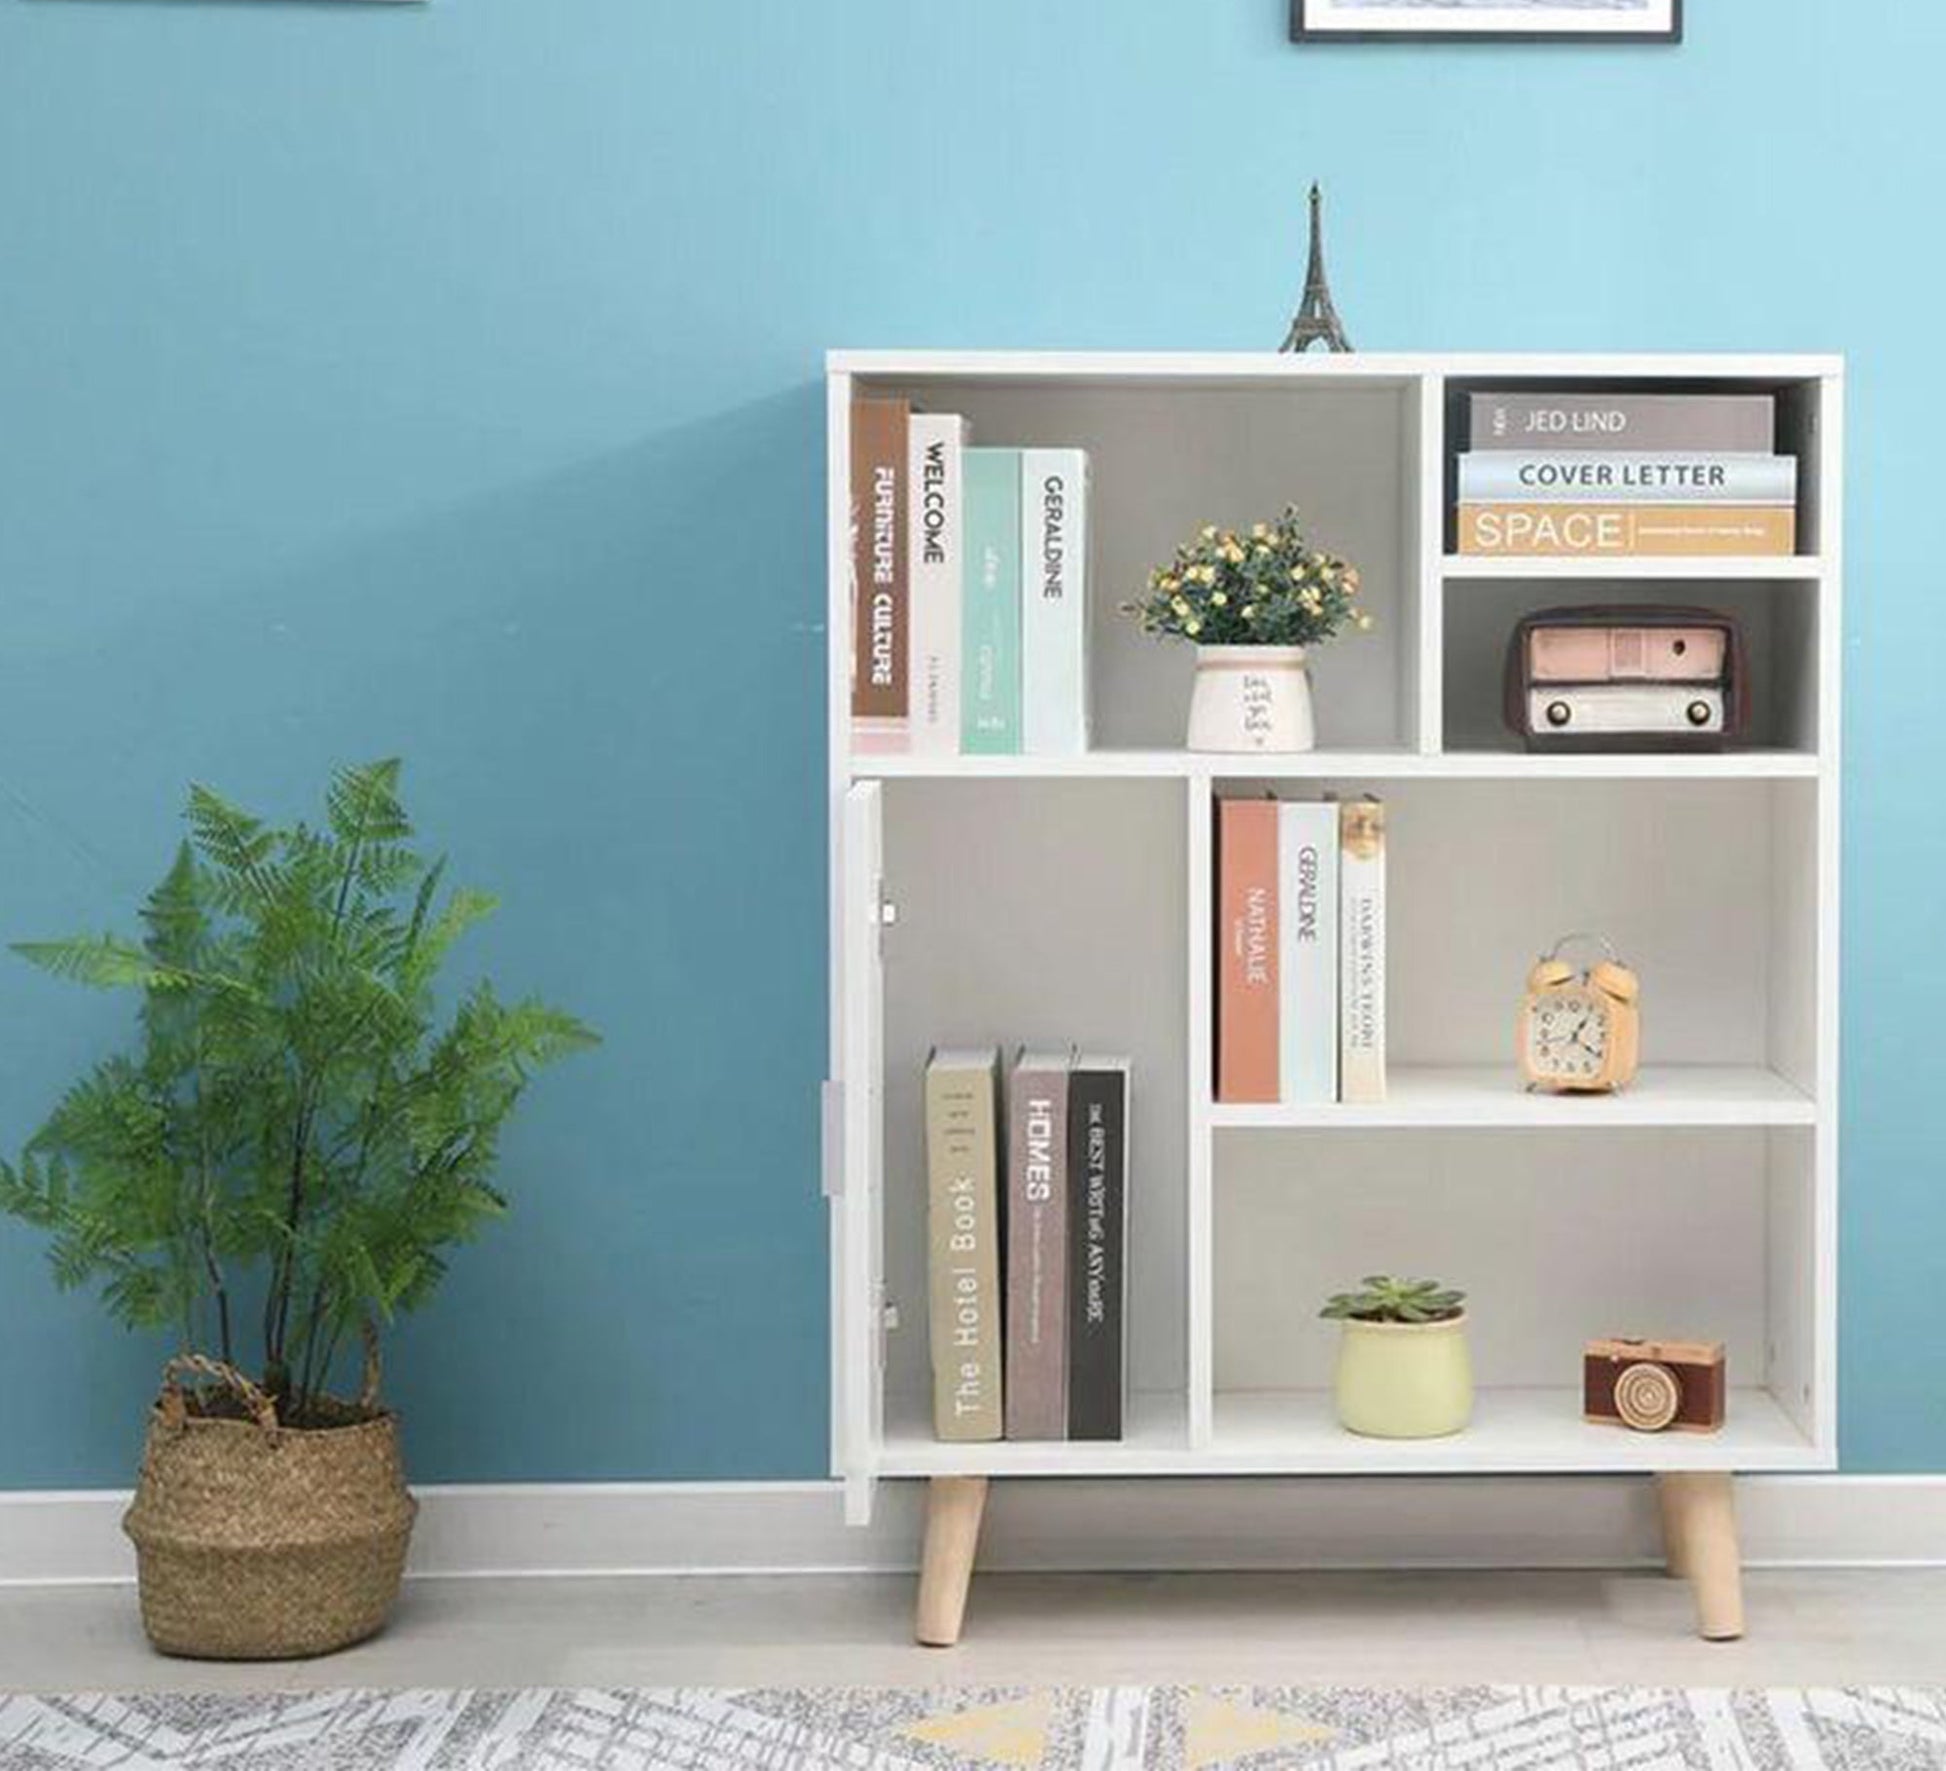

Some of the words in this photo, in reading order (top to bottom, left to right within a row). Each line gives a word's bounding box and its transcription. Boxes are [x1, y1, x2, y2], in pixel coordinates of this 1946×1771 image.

[1525, 410, 1567, 432] JED
[1572, 410, 1627, 432] LIND
[924, 442, 945, 564] WELCOME
[1519, 465, 1614, 486] COVER
[1623, 465, 1726, 486] LETTER
[872, 467, 894, 583] FURNITURE
[1042, 475, 1063, 600] GERALDINE
[1474, 512, 1623, 548] SPACE
[872, 594, 893, 686] CULTURE
[1246, 887, 1268, 985] NATHALIE
[1297, 846, 1318, 943] GERALDINE
[1026, 1100, 1052, 1201] HOMES
[948, 1175, 976, 1252] Book
[952, 1267, 979, 1347] Hotel
[954, 1362, 981, 1417] The
